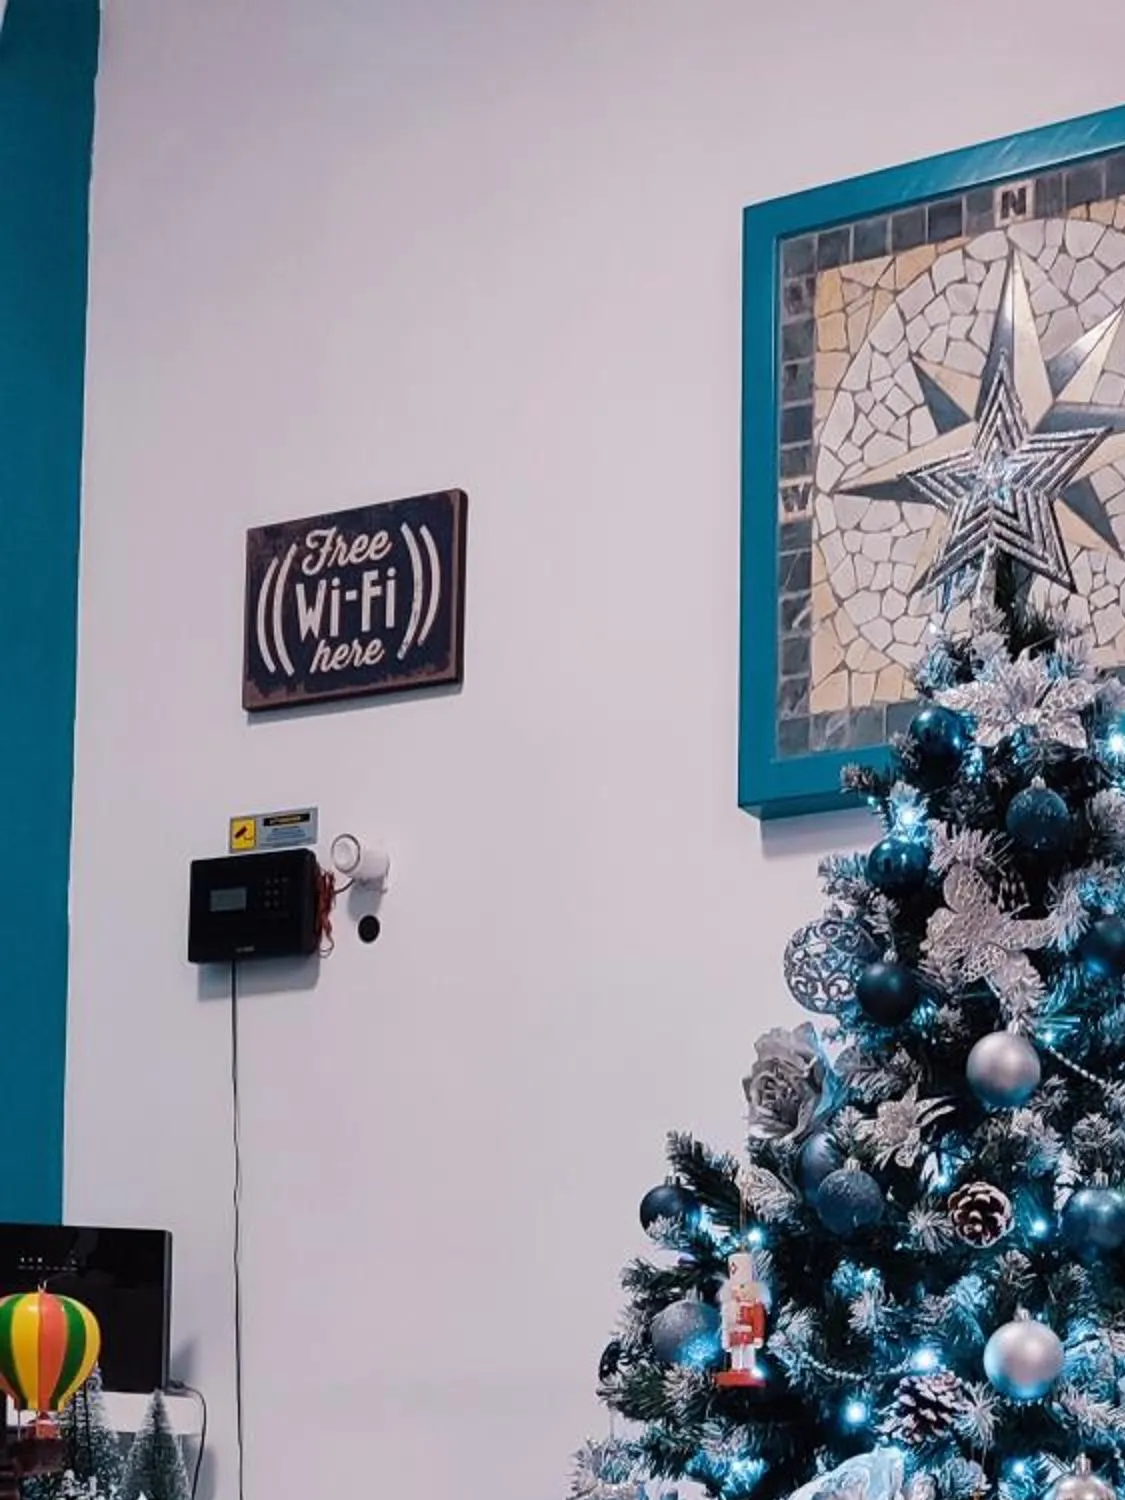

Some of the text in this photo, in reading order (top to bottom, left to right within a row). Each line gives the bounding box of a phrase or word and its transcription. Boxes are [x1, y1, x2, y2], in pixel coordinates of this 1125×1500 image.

[1001, 186, 1027, 219] N
[301, 526, 393, 576] Free
[295, 566, 397, 642] Wi-Fi
[309, 638, 385, 673] here
